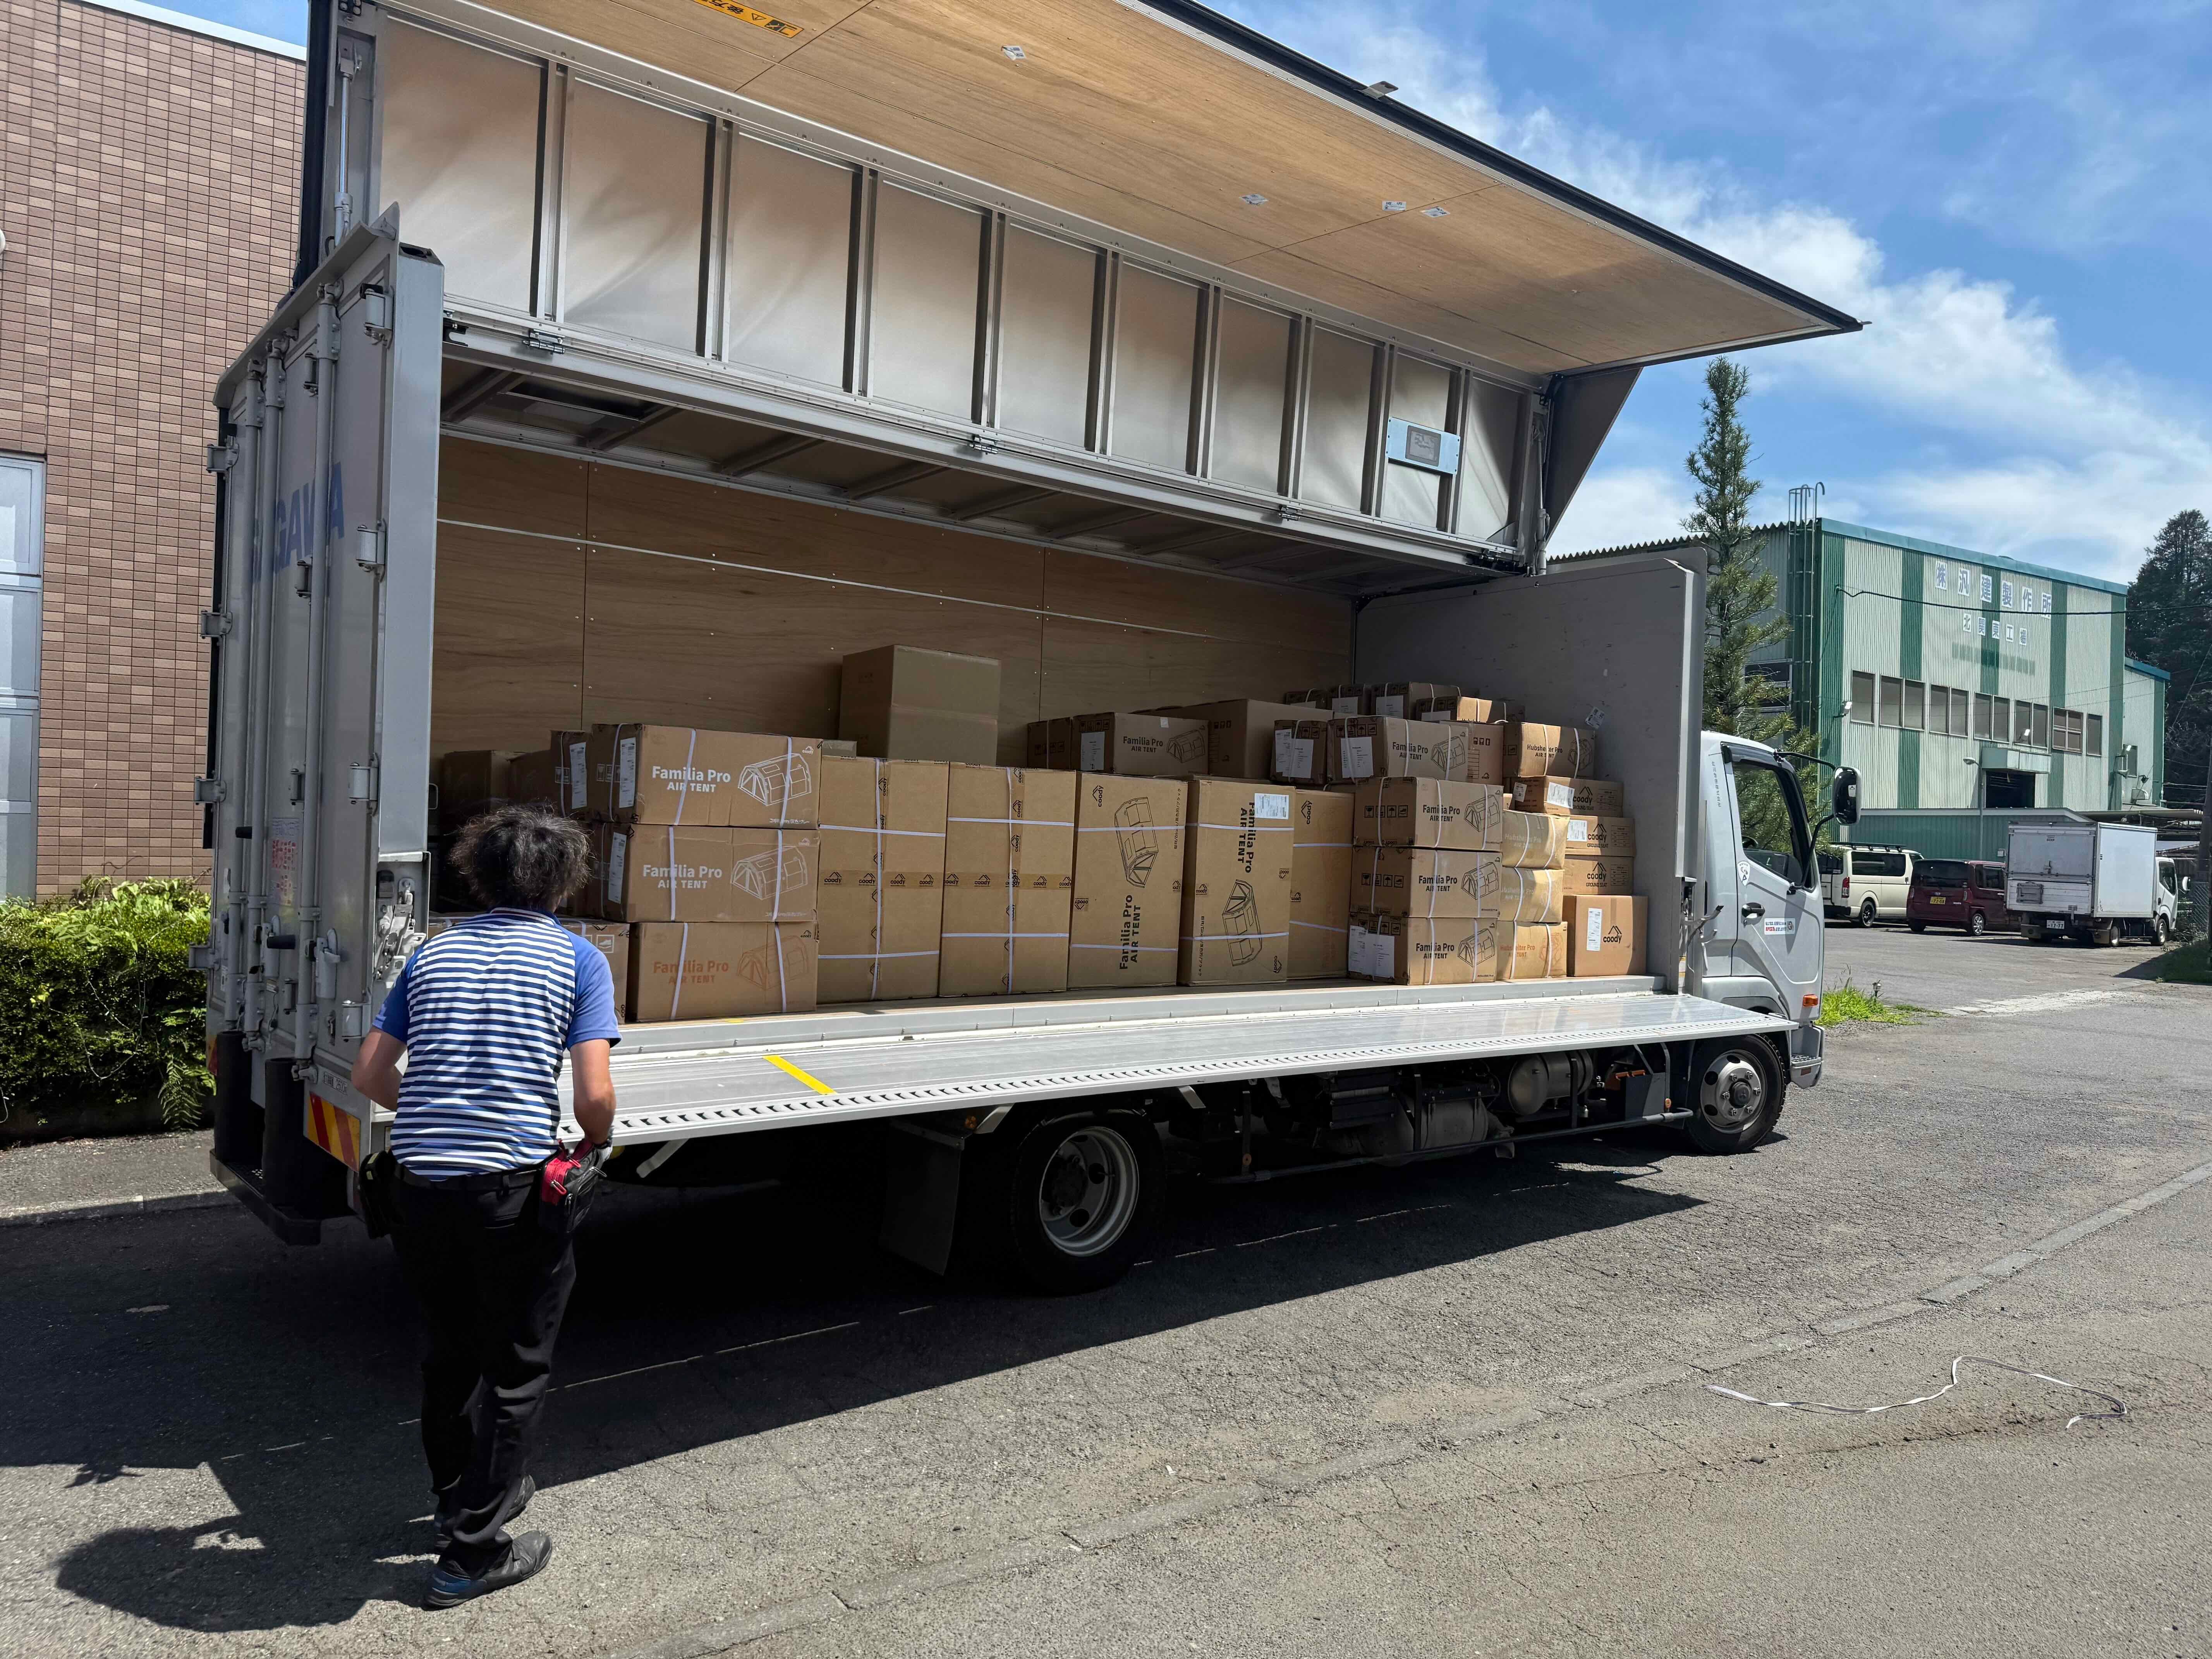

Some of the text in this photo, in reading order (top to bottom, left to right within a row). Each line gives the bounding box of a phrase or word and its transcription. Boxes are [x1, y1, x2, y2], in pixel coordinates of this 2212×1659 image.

[1123, 736, 1150, 745] Familia
[1392, 742, 1428, 754] Famlia Pro
[708, 769, 731, 783] Pro
[690, 783, 716, 793] TENT
[1573, 794, 1593, 805] coody
[1423, 804, 1460, 815] Famiia Pro
[1587, 833, 1607, 843] coody
[1238, 833, 1246, 863] TENT
[1245, 852, 1254, 873] Pro
[699, 866, 723, 878] Pro
[1587, 872, 1606, 882] coody
[681, 880, 708, 889] TENT
[1419, 875, 1458, 884] Famlia Pro
[1123, 895, 1133, 917] Pro
[1130, 905, 1141, 963] AIR TENT
[1603, 934, 1622, 944] coody
[1416, 943, 1455, 951] Famiia Pro
[707, 961, 729, 972] Pro
[668, 975, 715, 985] AR TENT
